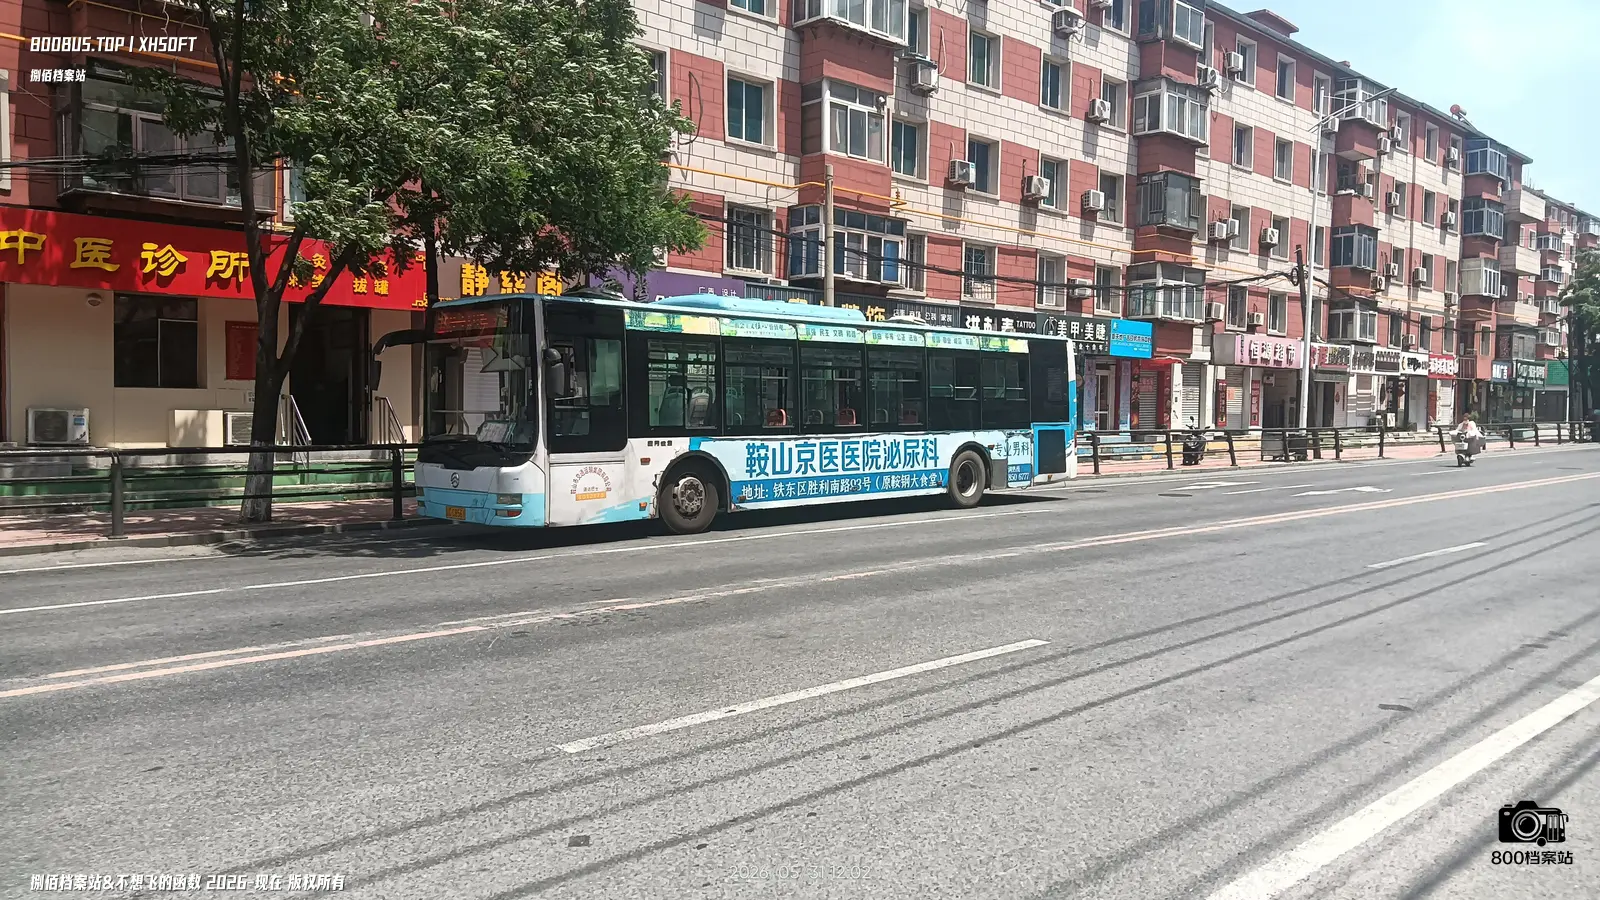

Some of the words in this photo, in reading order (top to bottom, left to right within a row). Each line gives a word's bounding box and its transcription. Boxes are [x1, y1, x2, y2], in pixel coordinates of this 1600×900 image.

[0, 228, 249, 283] 中医诊所
[353, 277, 389, 295] 拔罐
[1016, 320, 1036, 329] TATTOO
[745, 437, 939, 478] 鞍山京医医院泌尿科
[994, 441, 1030, 457] 专业男科
